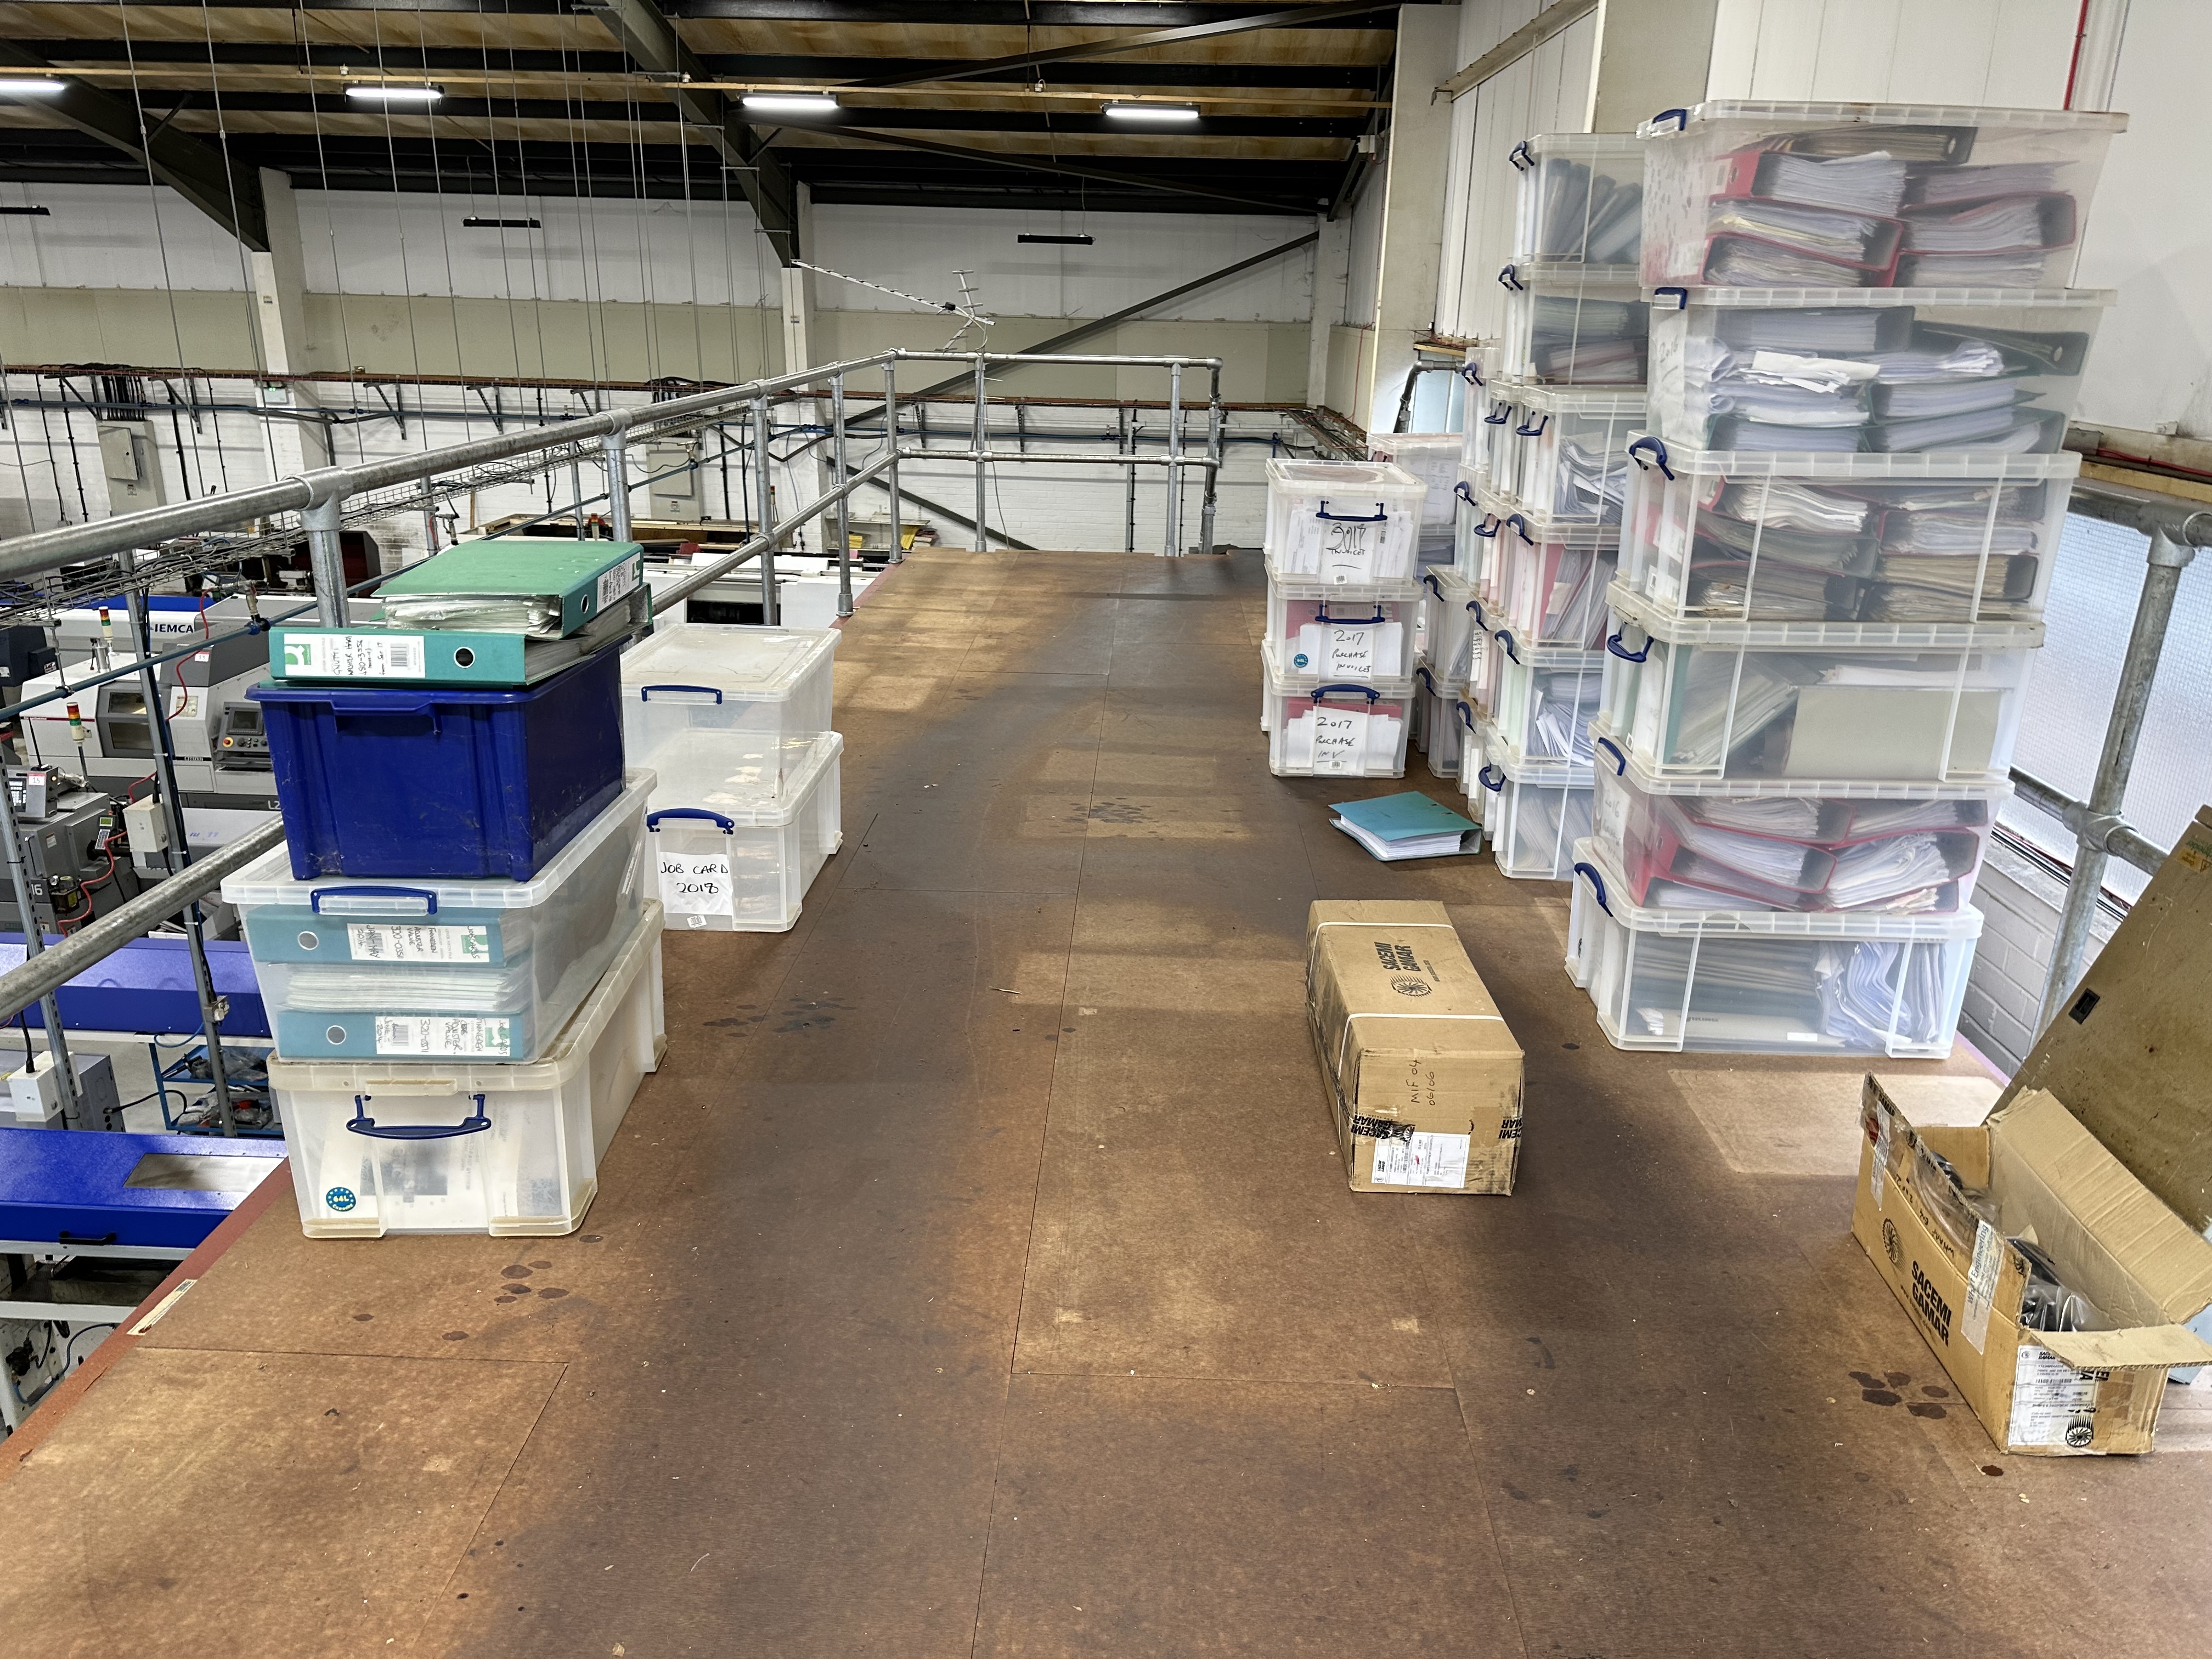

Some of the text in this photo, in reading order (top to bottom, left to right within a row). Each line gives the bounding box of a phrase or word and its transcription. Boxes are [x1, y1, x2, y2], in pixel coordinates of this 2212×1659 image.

[155, 624, 193, 633] IEMCA
[1334, 630, 1364, 645] 2017
[1317, 717, 1352, 729] 2017
[661, 862, 729, 874] JOB CARD
[31, 884, 43, 895] 16
[676, 882, 719, 894] 2018
[1374, 942, 1401, 970] SACEMI
[1394, 945, 1421, 971] GAMAR
[1406, 1059, 1422, 1103] MIF 04
[1974, 1224, 1989, 1277] Engineering
[1911, 1260, 1951, 1327] SACEMI
[1912, 1282, 1949, 1347] GAMAR
